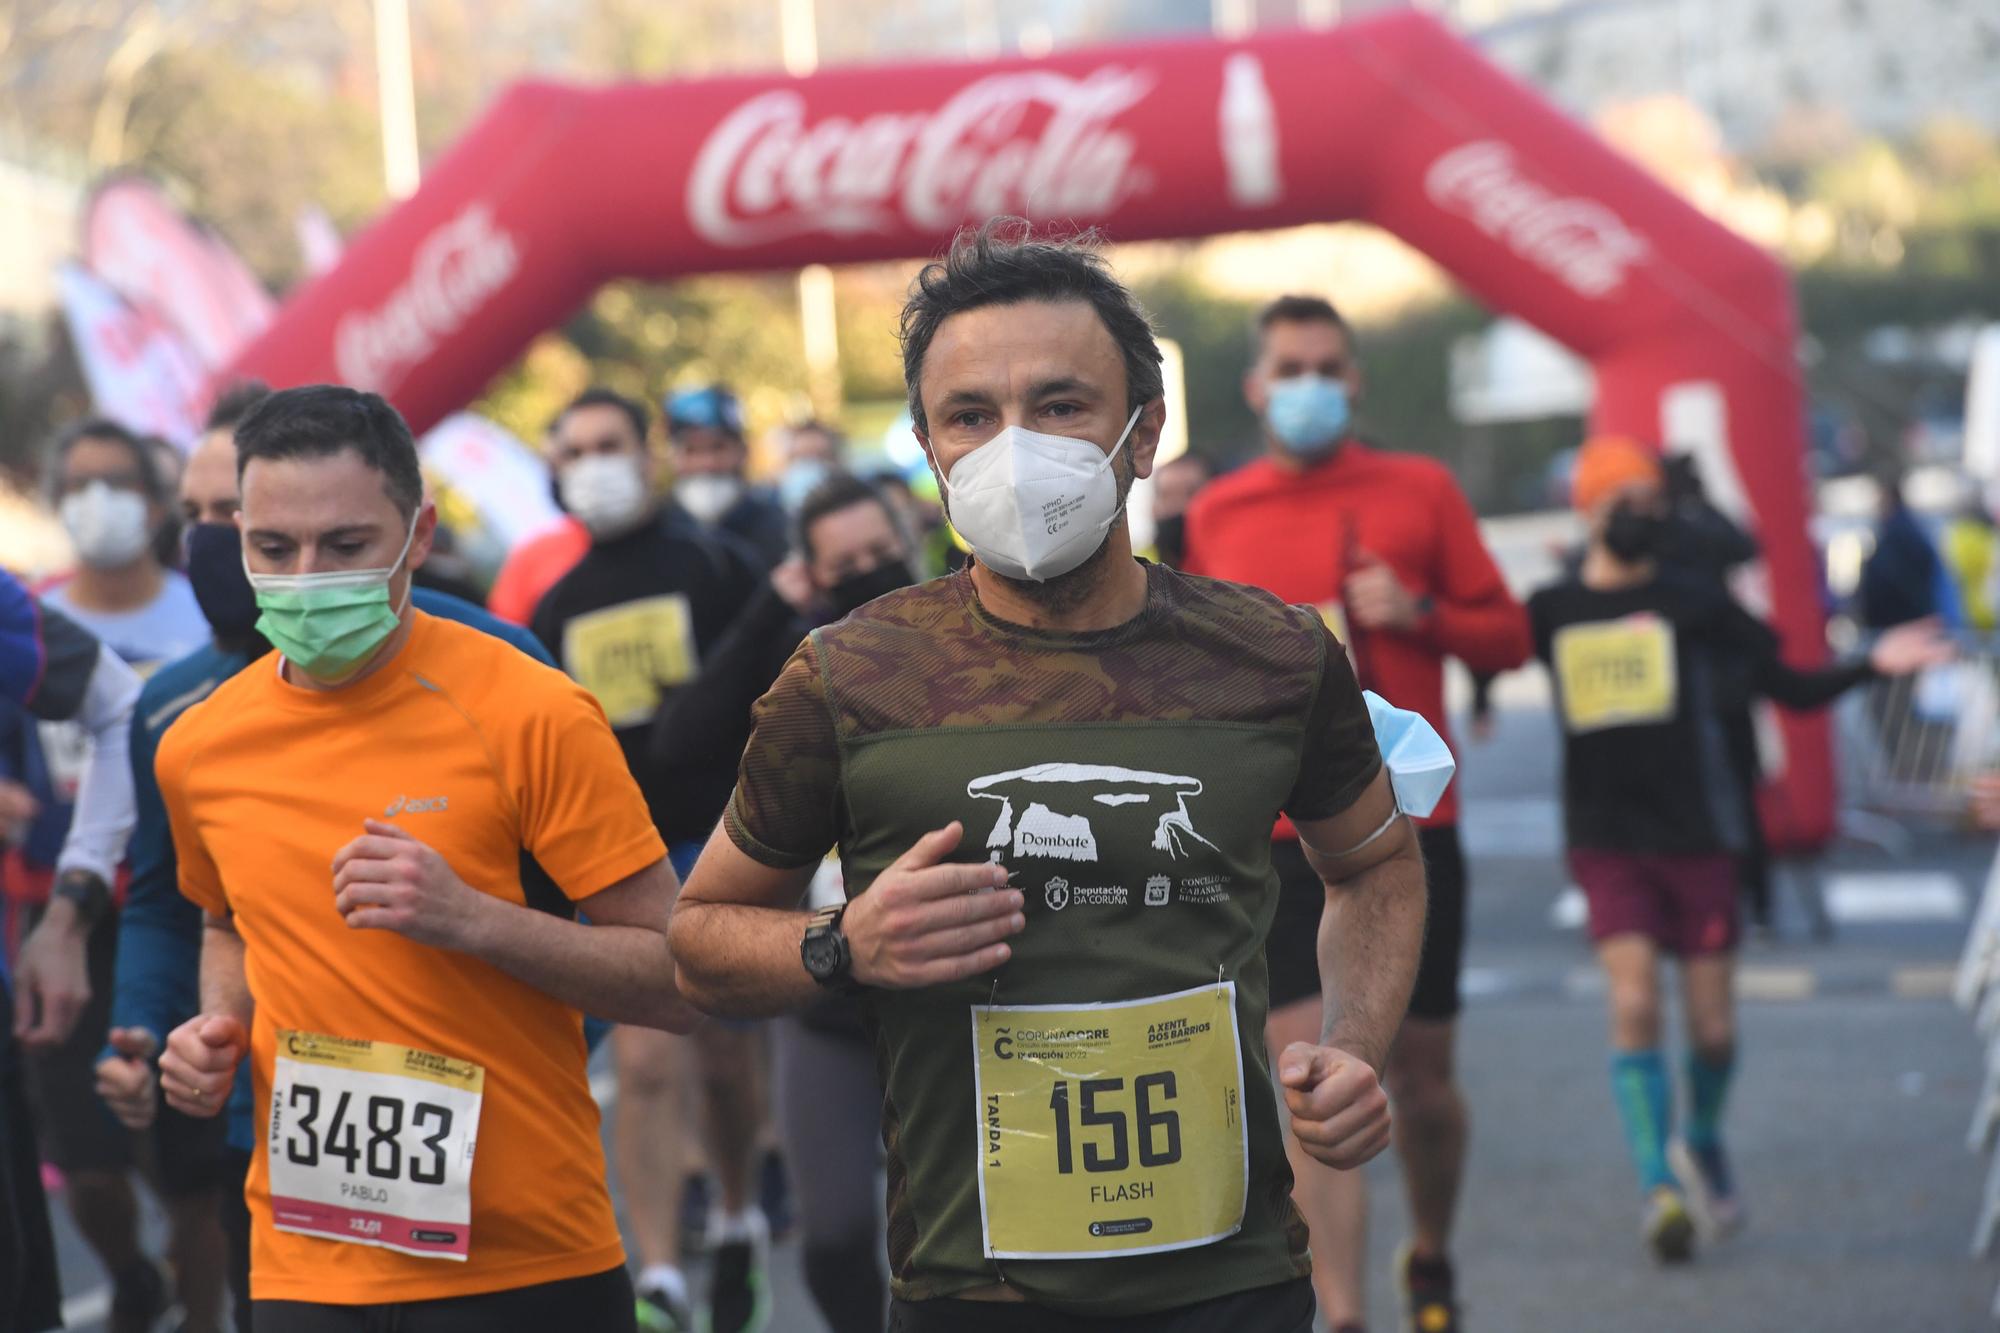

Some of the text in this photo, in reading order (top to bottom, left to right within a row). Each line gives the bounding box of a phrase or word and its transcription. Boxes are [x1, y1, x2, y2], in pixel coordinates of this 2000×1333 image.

[1021, 832, 1089, 849] Dombate
[1073, 885, 1128, 897] Deputación
[1073, 893, 1128, 905] DA CORUÑA
[1148, 1018, 1188, 1034] A XENTE
[1148, 1022, 1211, 1043] DOS BARRIOS
[986, 1094, 1002, 1154] TANDA
[1049, 1070, 1182, 1174] 156
[287, 1083, 453, 1185] 3483
[340, 1182, 389, 1204] PABLO
[1090, 1181, 1154, 1203] FLASH
